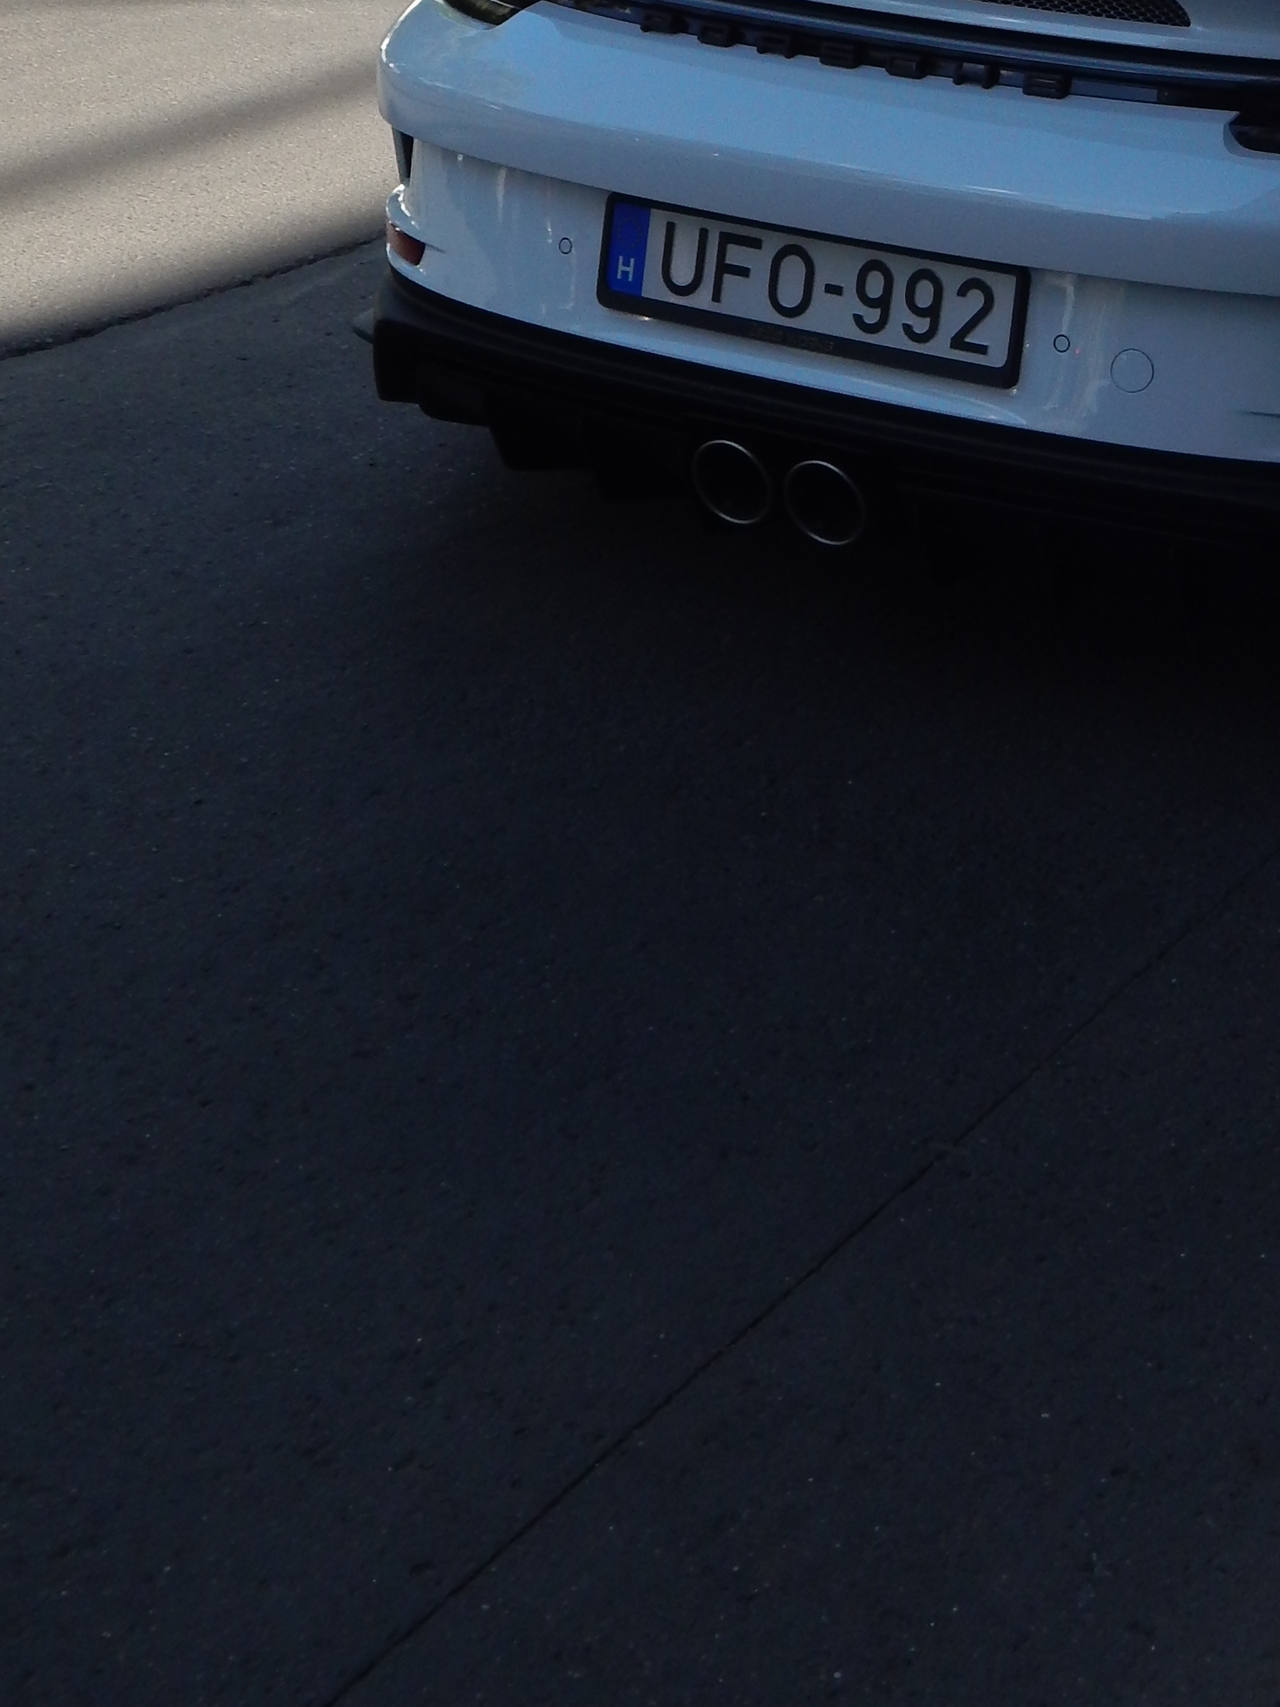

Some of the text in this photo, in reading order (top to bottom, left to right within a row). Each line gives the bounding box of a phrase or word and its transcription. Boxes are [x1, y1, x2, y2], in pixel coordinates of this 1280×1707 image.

[640, 7, 1072, 100] PORSCHE
[616, 255, 636, 283] H
[660, 220, 995, 356] UFO-992
